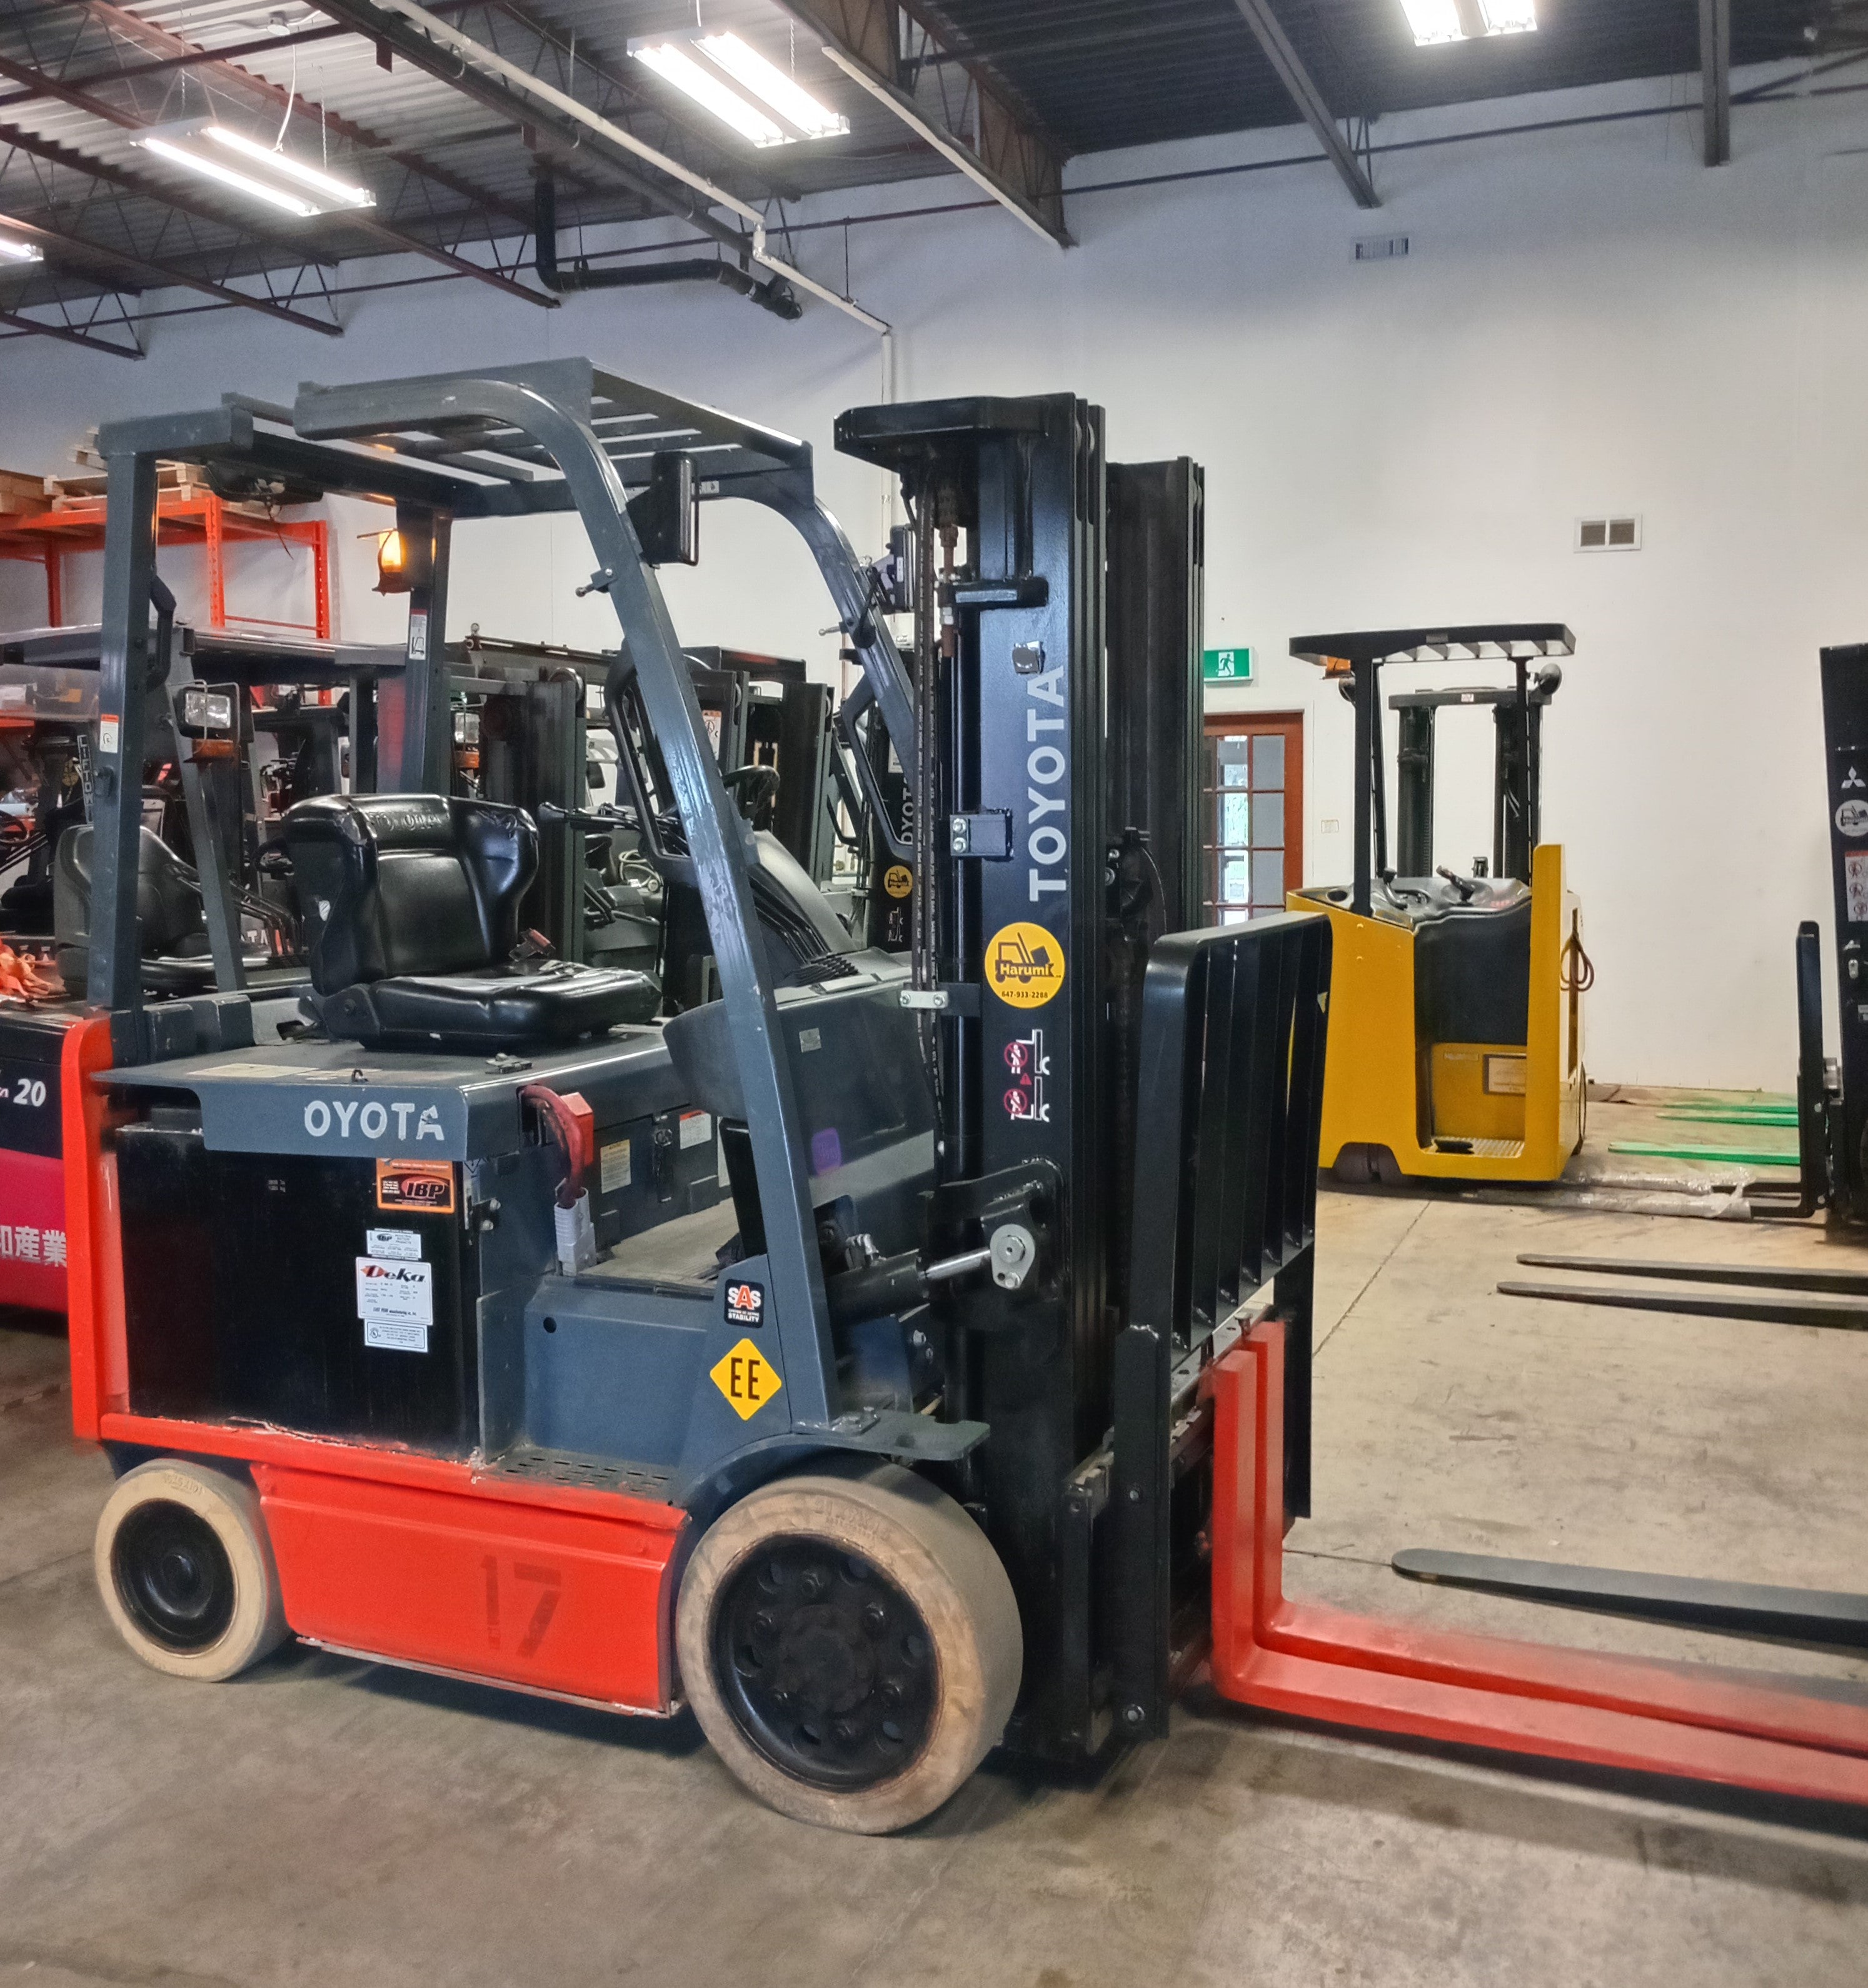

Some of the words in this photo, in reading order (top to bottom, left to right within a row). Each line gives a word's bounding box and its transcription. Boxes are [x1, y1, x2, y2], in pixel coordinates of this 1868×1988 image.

[1027, 666, 1067, 901] TOYOTA
[1000, 963, 1049, 976] Harumi
[13, 1078, 46, 1107] 20
[304, 1100, 444, 1140] OYOTA
[406, 1181, 444, 1198] IBP
[361, 1265, 424, 1282] Deka
[728, 1285, 761, 1309] SAS
[731, 1357, 760, 1400] EE
[481, 1555, 562, 1659] 17
